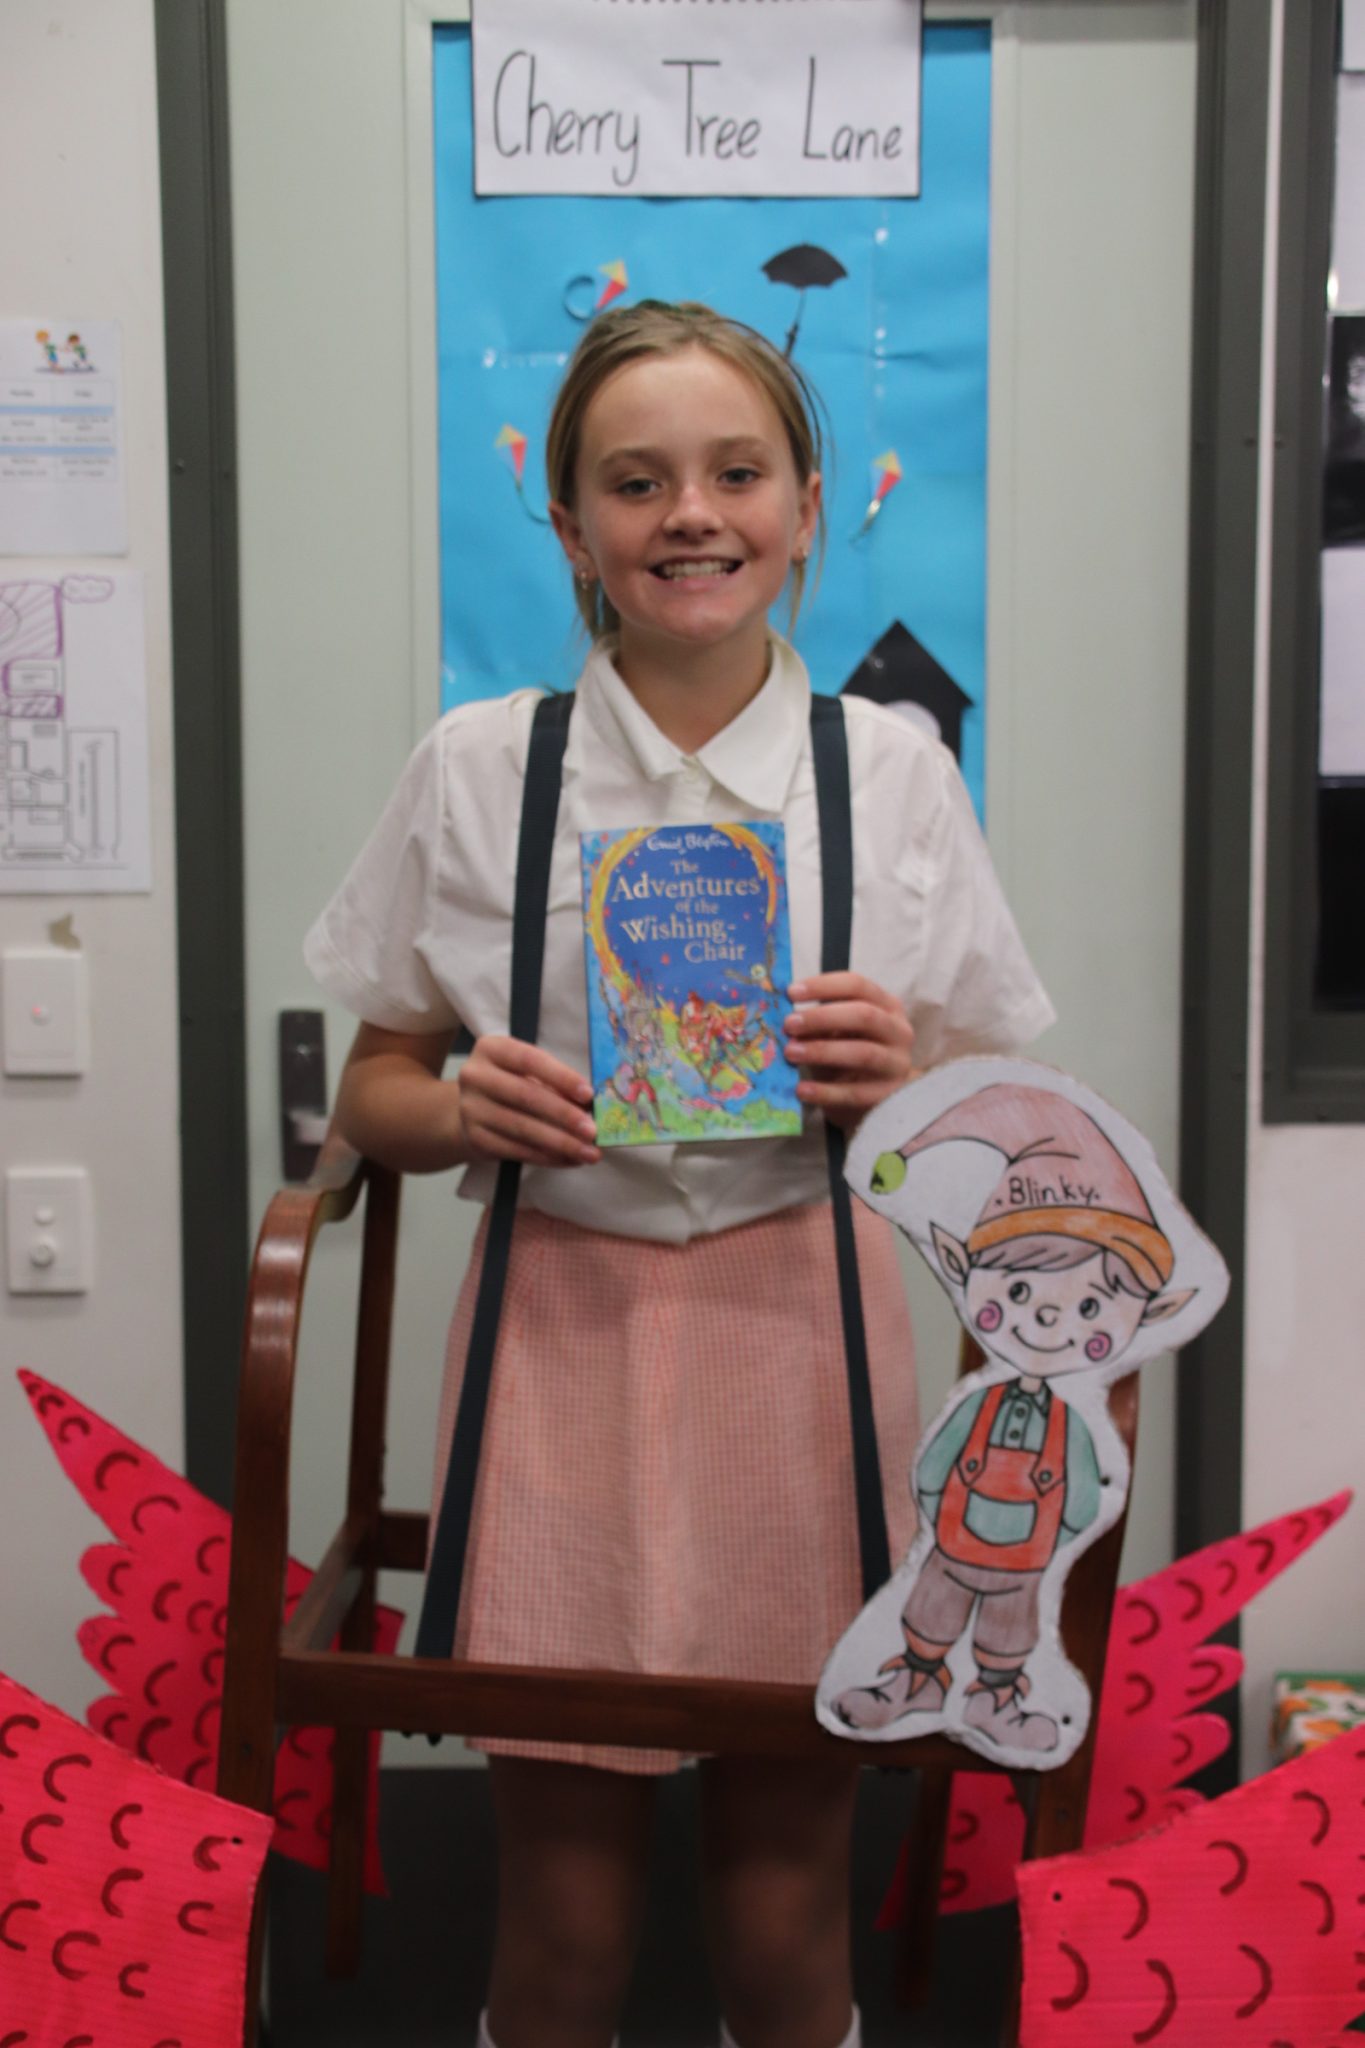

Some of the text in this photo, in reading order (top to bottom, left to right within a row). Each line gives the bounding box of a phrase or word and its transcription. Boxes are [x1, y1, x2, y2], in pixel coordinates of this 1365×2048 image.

[494, 50, 902, 187] Cherry Tree Lane
[671, 859, 699, 875] The
[611, 871, 760, 902] Adventures
[675, 899, 719, 914] of the
[684, 937, 747, 963] Chair
